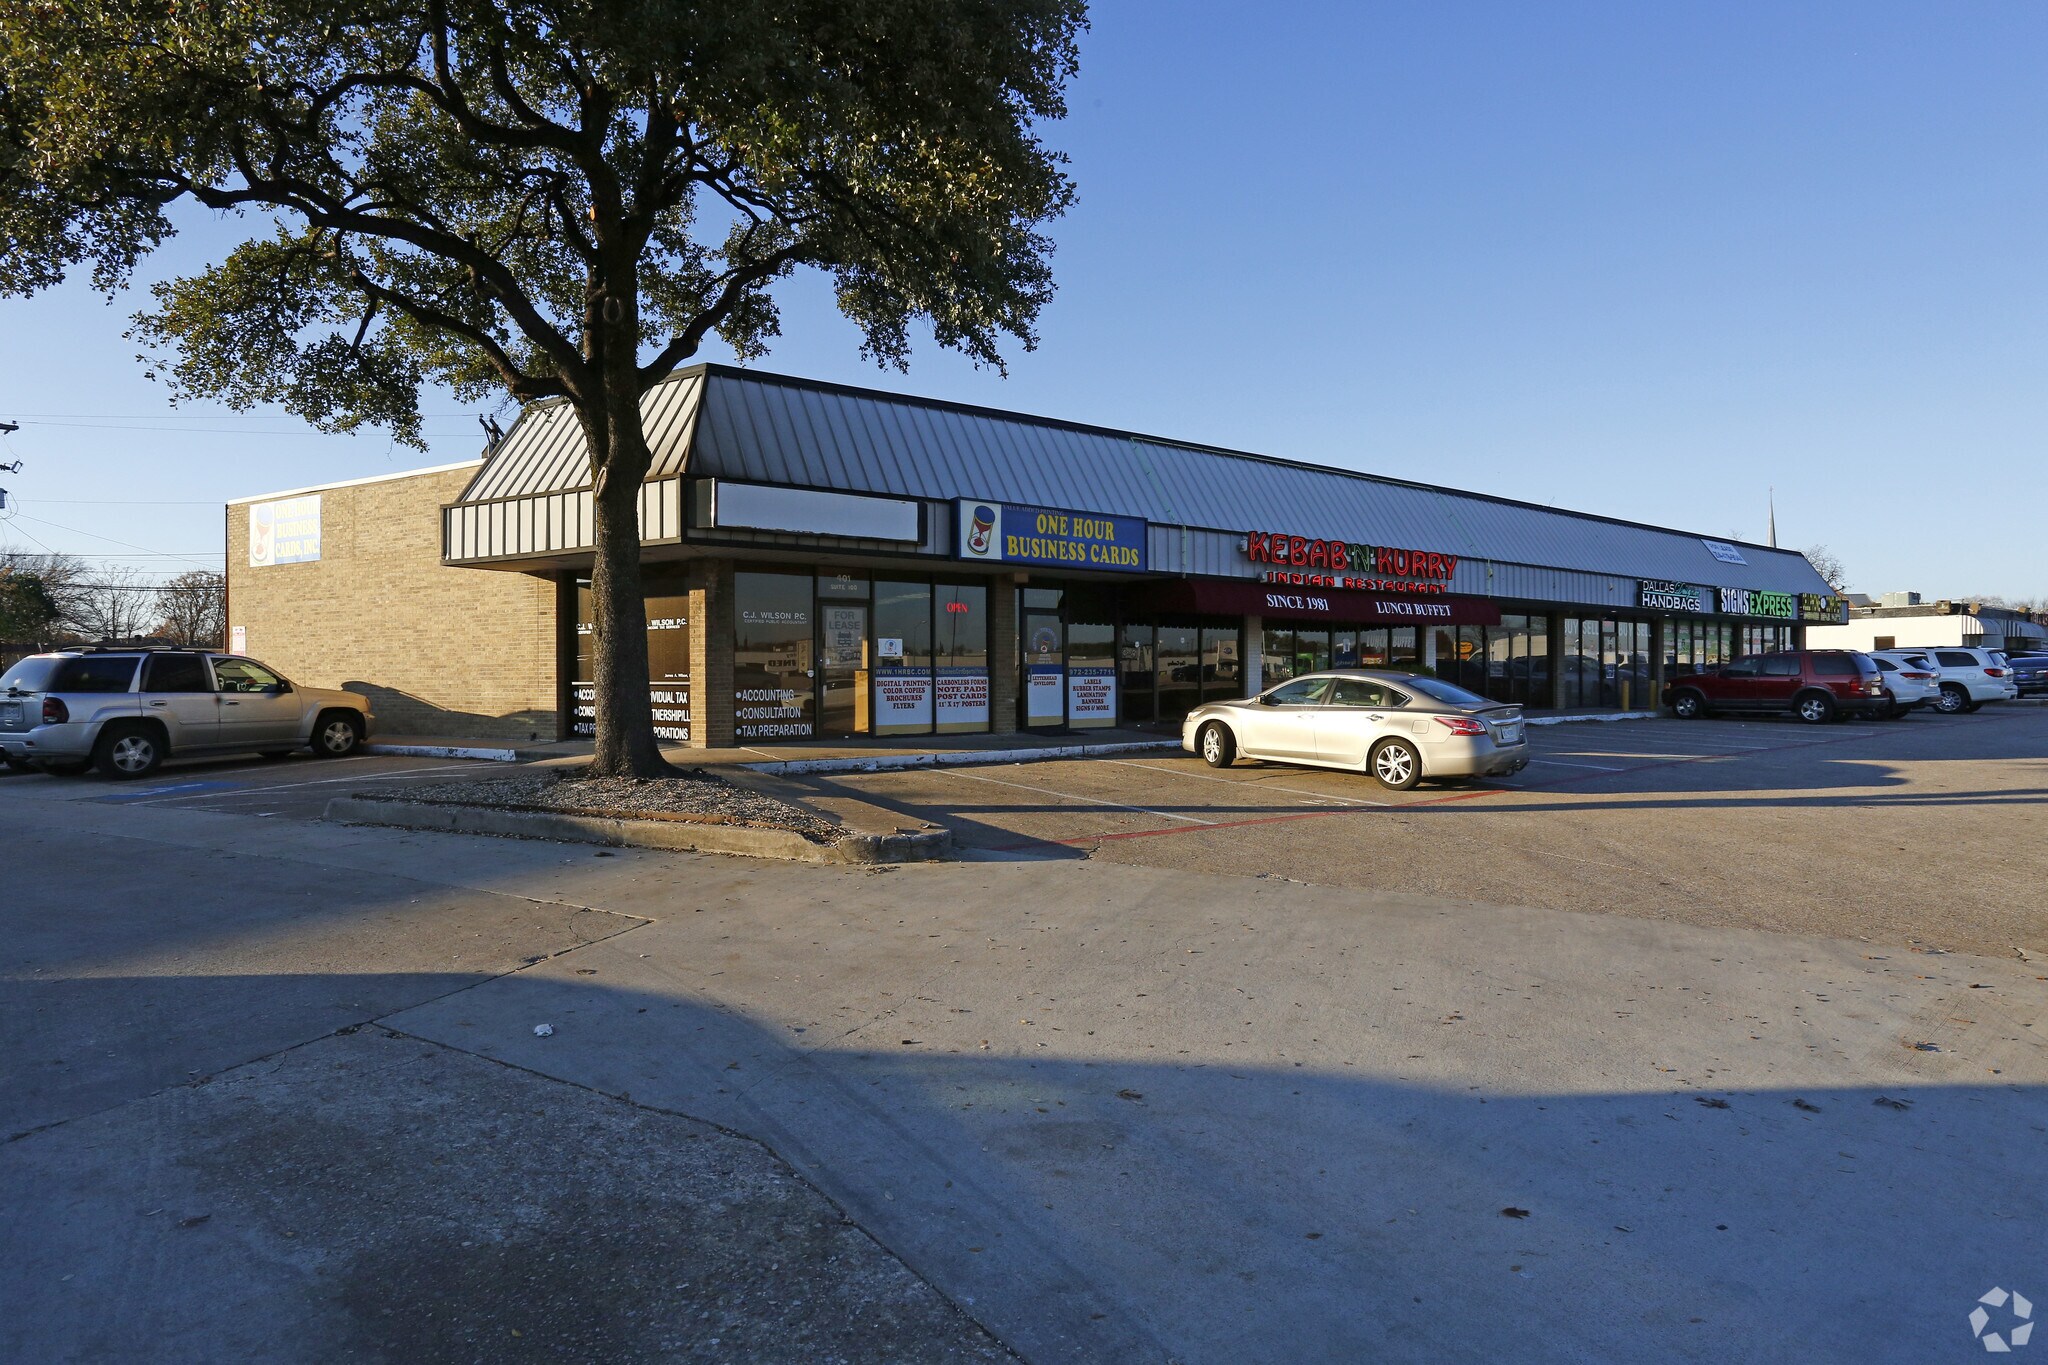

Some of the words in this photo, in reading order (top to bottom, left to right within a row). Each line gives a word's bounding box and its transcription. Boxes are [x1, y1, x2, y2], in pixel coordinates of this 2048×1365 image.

[277, 520, 317, 538] BUSINESS
[1036, 513, 1068, 536] ONE
[1073, 517, 1115, 541] HOUR
[1007, 535, 1086, 561] BUSINESS
[1090, 544, 1139, 566] CARDS
[1249, 530, 1348, 570] KEBAB
[1377, 547, 1458, 580] KURRY
[1267, 571, 1336, 586] INDIAN
[1343, 577, 1448, 593] RESTAURANT
[1643, 580, 1675, 594] DALLAS
[946, 602, 968, 614] OPEN
[1266, 593, 1303, 608] SINCE
[1307, 596, 1329, 611] 1981
[1376, 601, 1413, 615] LUNCH
[1415, 603, 1452, 616] BUFFET
[1642, 593, 1700, 611] HANDBAGS
[1721, 587, 1749, 614] SIGNS
[1750, 591, 1793, 617] EXPRESS
[834, 611, 855, 620] FOR
[828, 621, 861, 630] LEASE
[1366, 635, 1387, 647] LUNCH
[676, 692, 688, 704] TAX
[742, 689, 794, 702] ACCOUNTING
[742, 707, 800, 719] CONSULTATION
[578, 723, 588, 733] TAX
[653, 726, 689, 740] PORATIONS
[742, 725, 757, 737] TAX
[759, 724, 812, 736] PREPARATION
